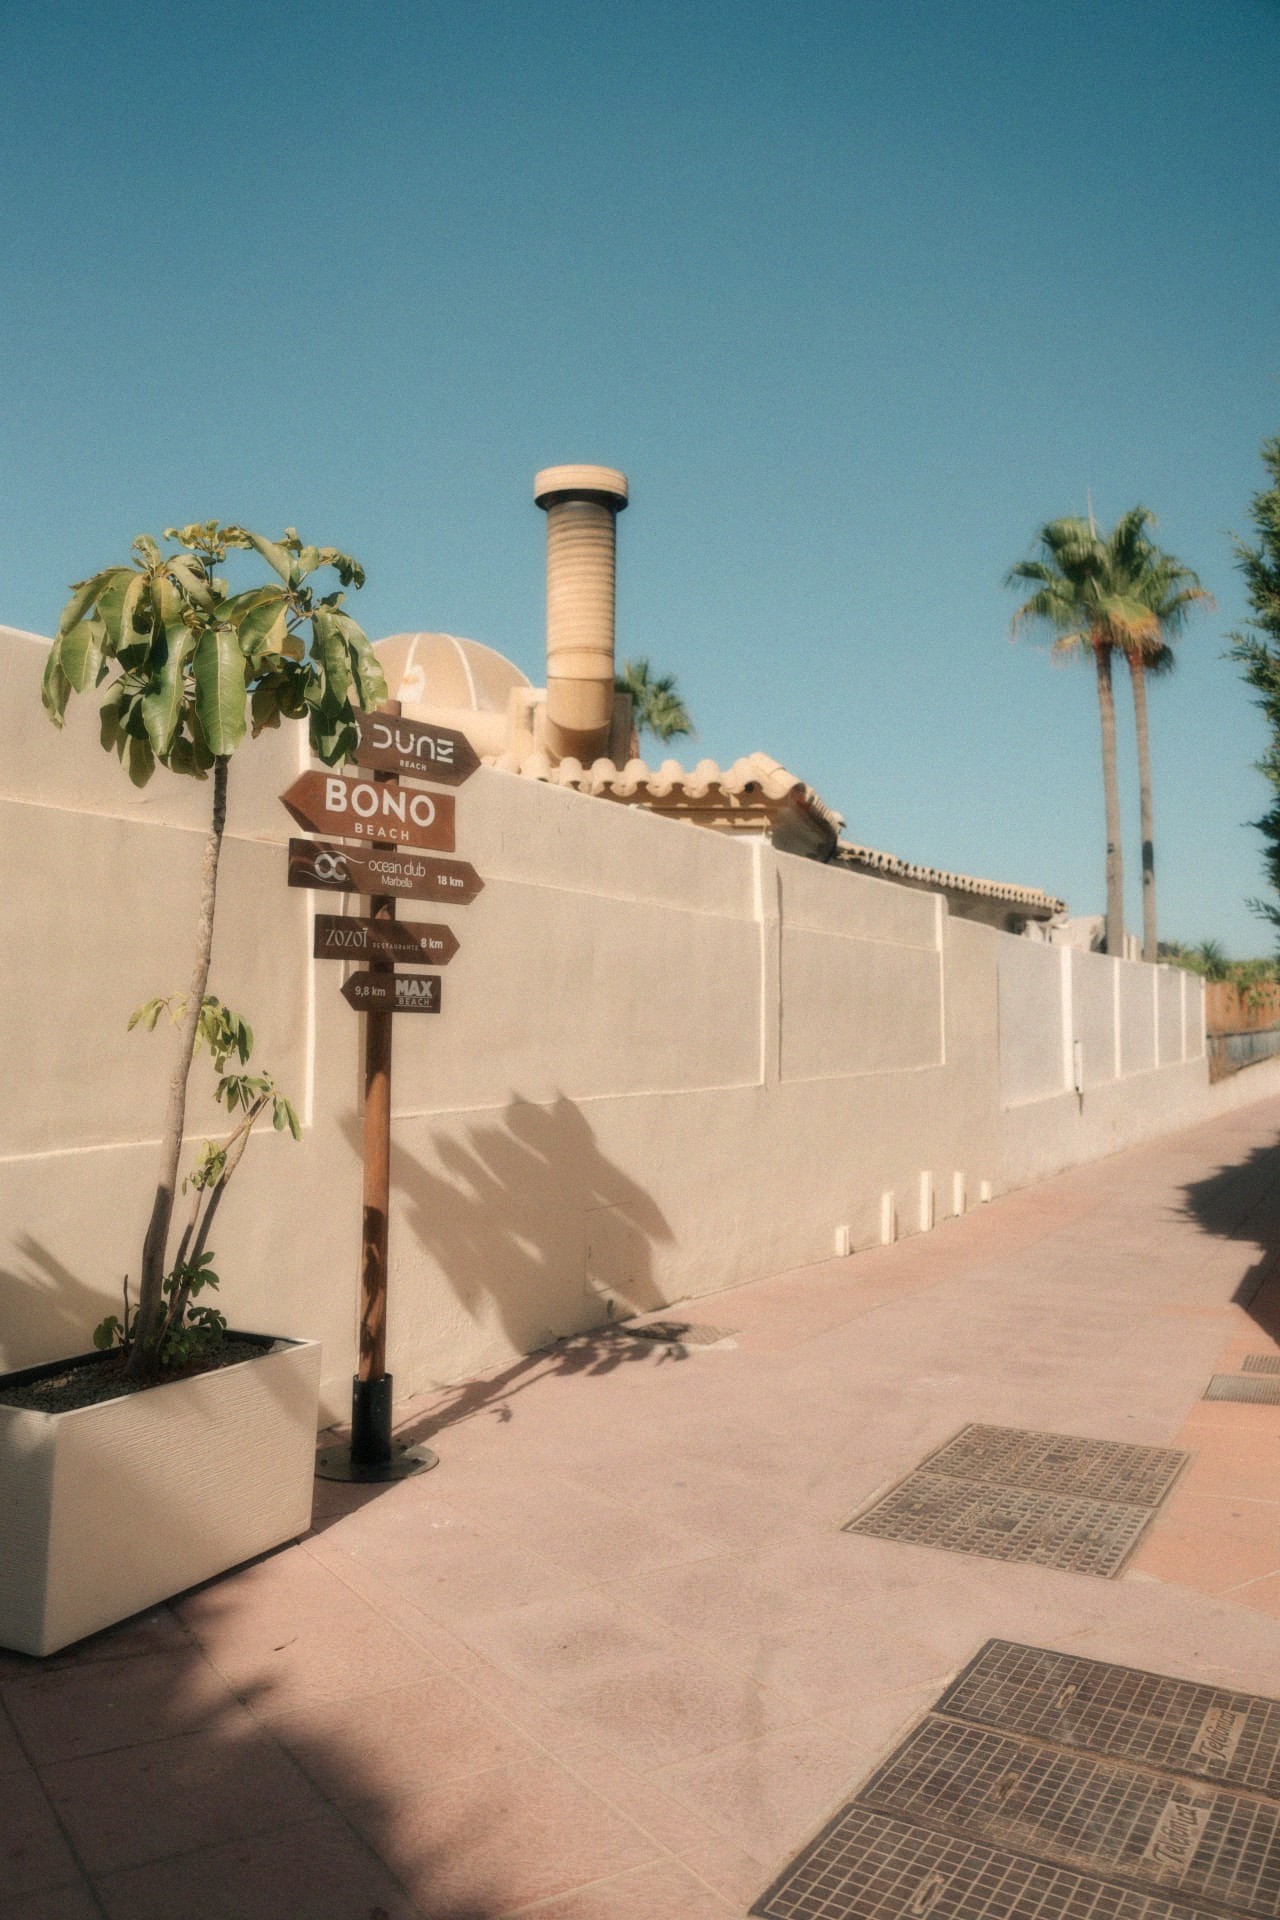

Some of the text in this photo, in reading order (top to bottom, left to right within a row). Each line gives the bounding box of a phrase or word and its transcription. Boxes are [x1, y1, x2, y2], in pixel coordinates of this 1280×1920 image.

[373, 724, 454, 764] DUNE
[401, 760, 427, 771] BEACH
[326, 779, 435, 827] BONO
[355, 824, 409, 841] BEACH
[368, 859, 426, 877] ocean club
[382, 876, 413, 888] Marbella
[437, 875, 464, 887] 18 km
[420, 938, 443, 949] 8 km
[355, 986, 386, 996] 9,8 km
[395, 980, 433, 996] MAX
[398, 997, 430, 1006] BEACH
